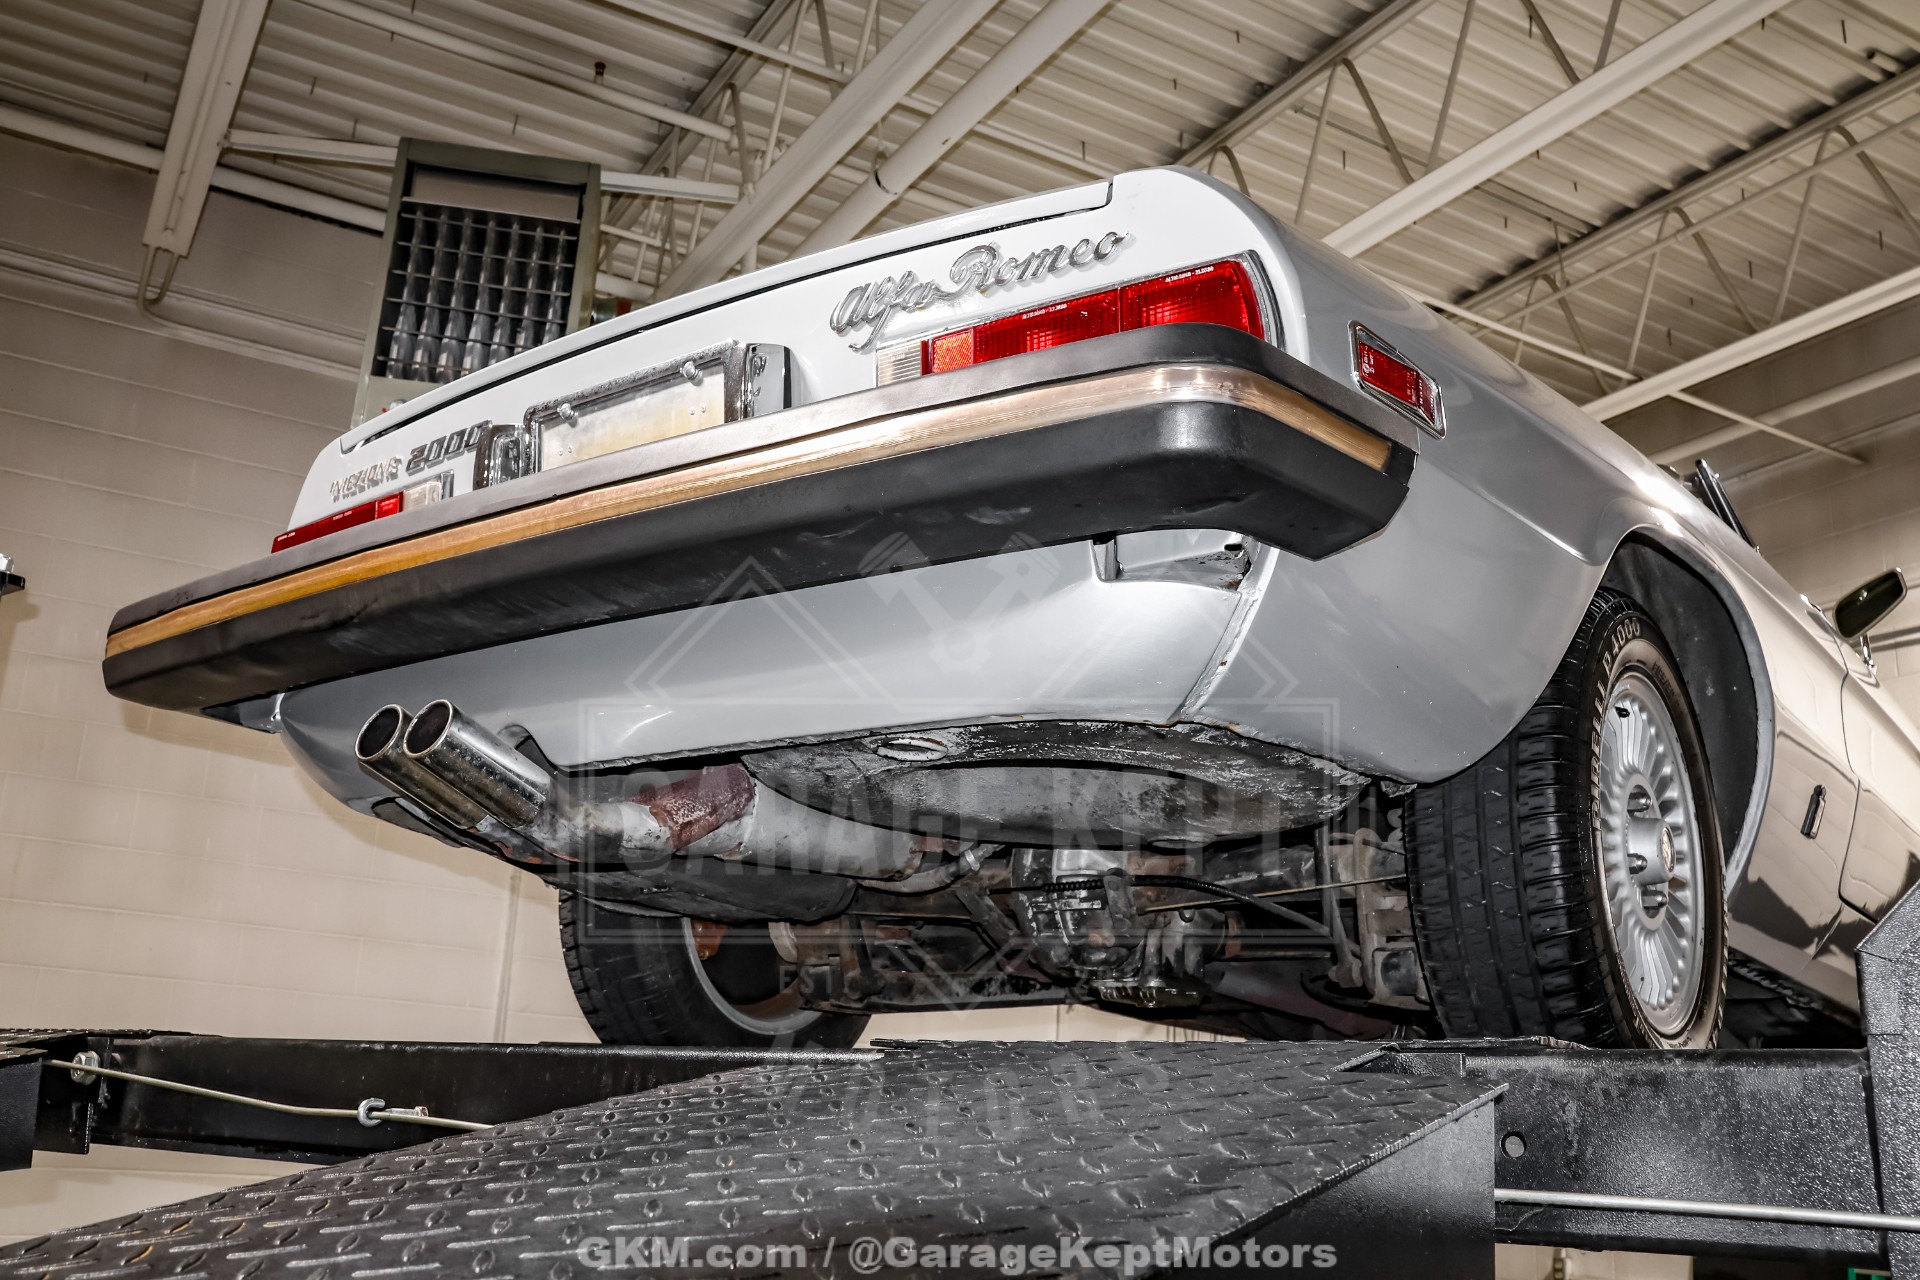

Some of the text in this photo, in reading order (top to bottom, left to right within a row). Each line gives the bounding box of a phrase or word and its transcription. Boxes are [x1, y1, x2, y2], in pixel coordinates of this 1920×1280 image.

[830, 232, 1130, 351] Alfa Romeo
[405, 420, 491, 473] 2000
[1591, 680, 1606, 829] PIRELLI
